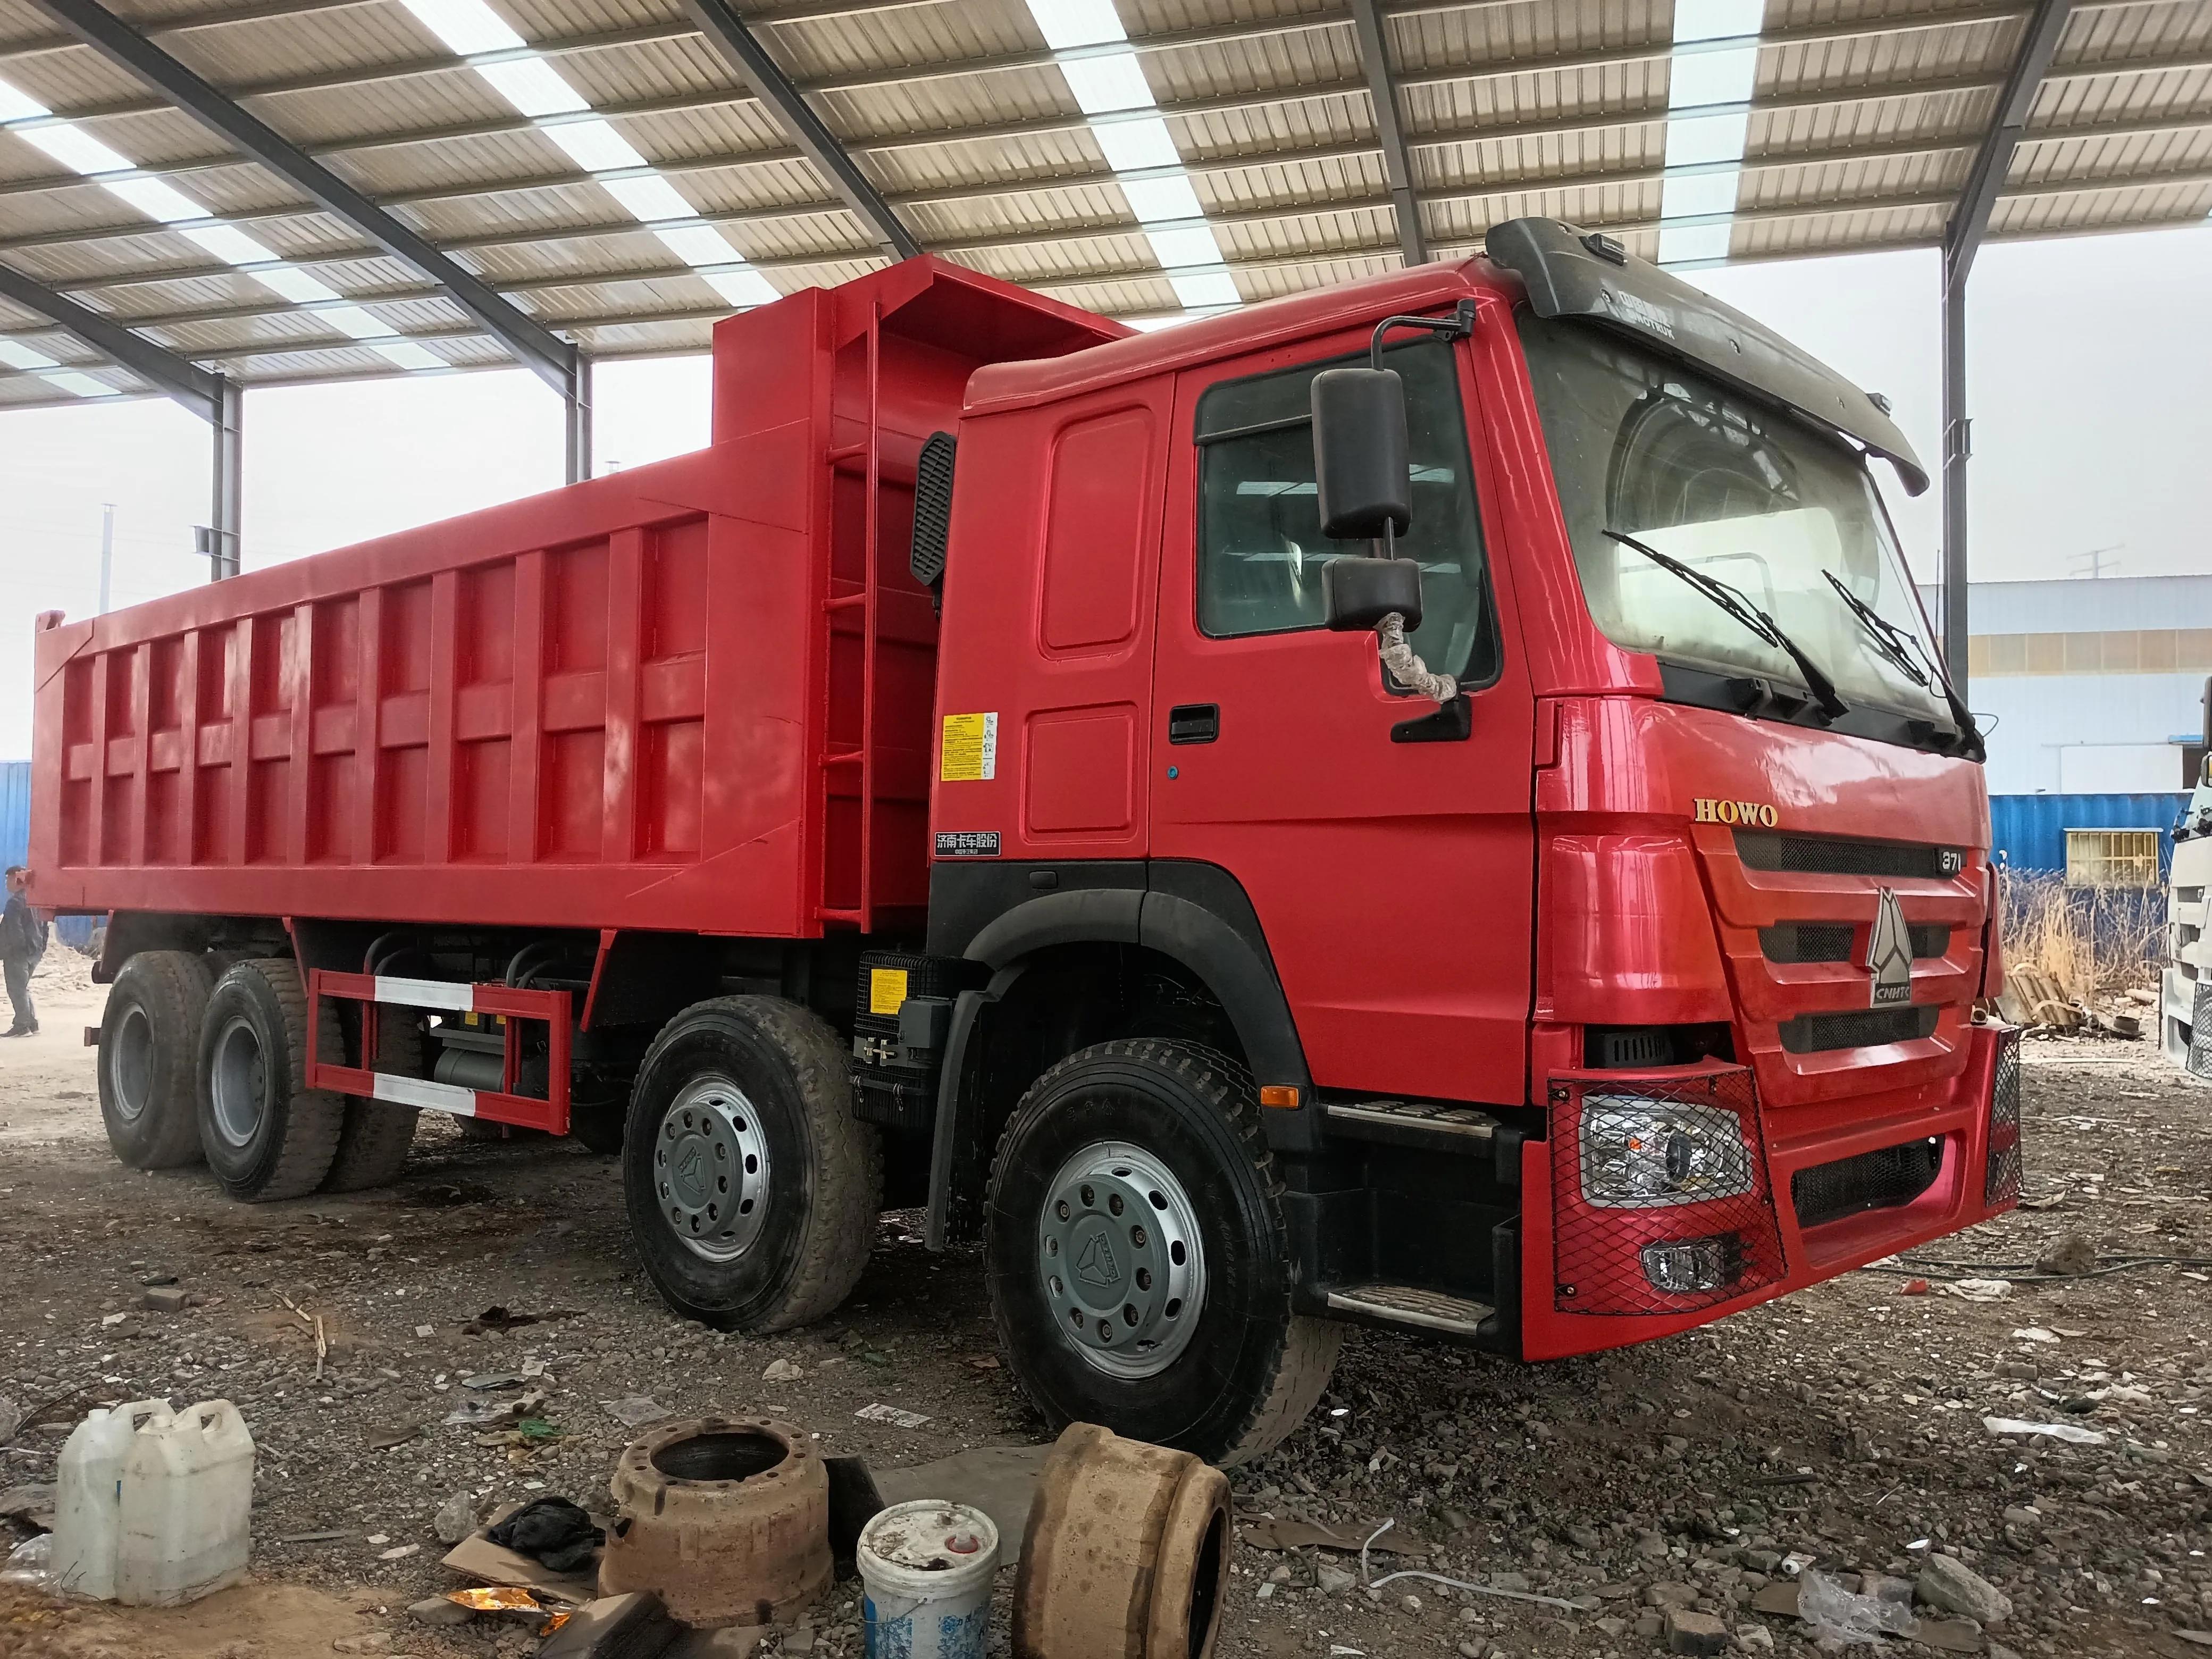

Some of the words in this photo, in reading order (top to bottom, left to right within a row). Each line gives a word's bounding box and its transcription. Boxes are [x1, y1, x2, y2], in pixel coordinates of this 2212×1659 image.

[1694, 798, 1778, 827] HOWO
[937, 833, 997, 848] 济南卡车股份
[1942, 851, 1961, 872] 371
[1876, 986, 1909, 999] CNHTC
